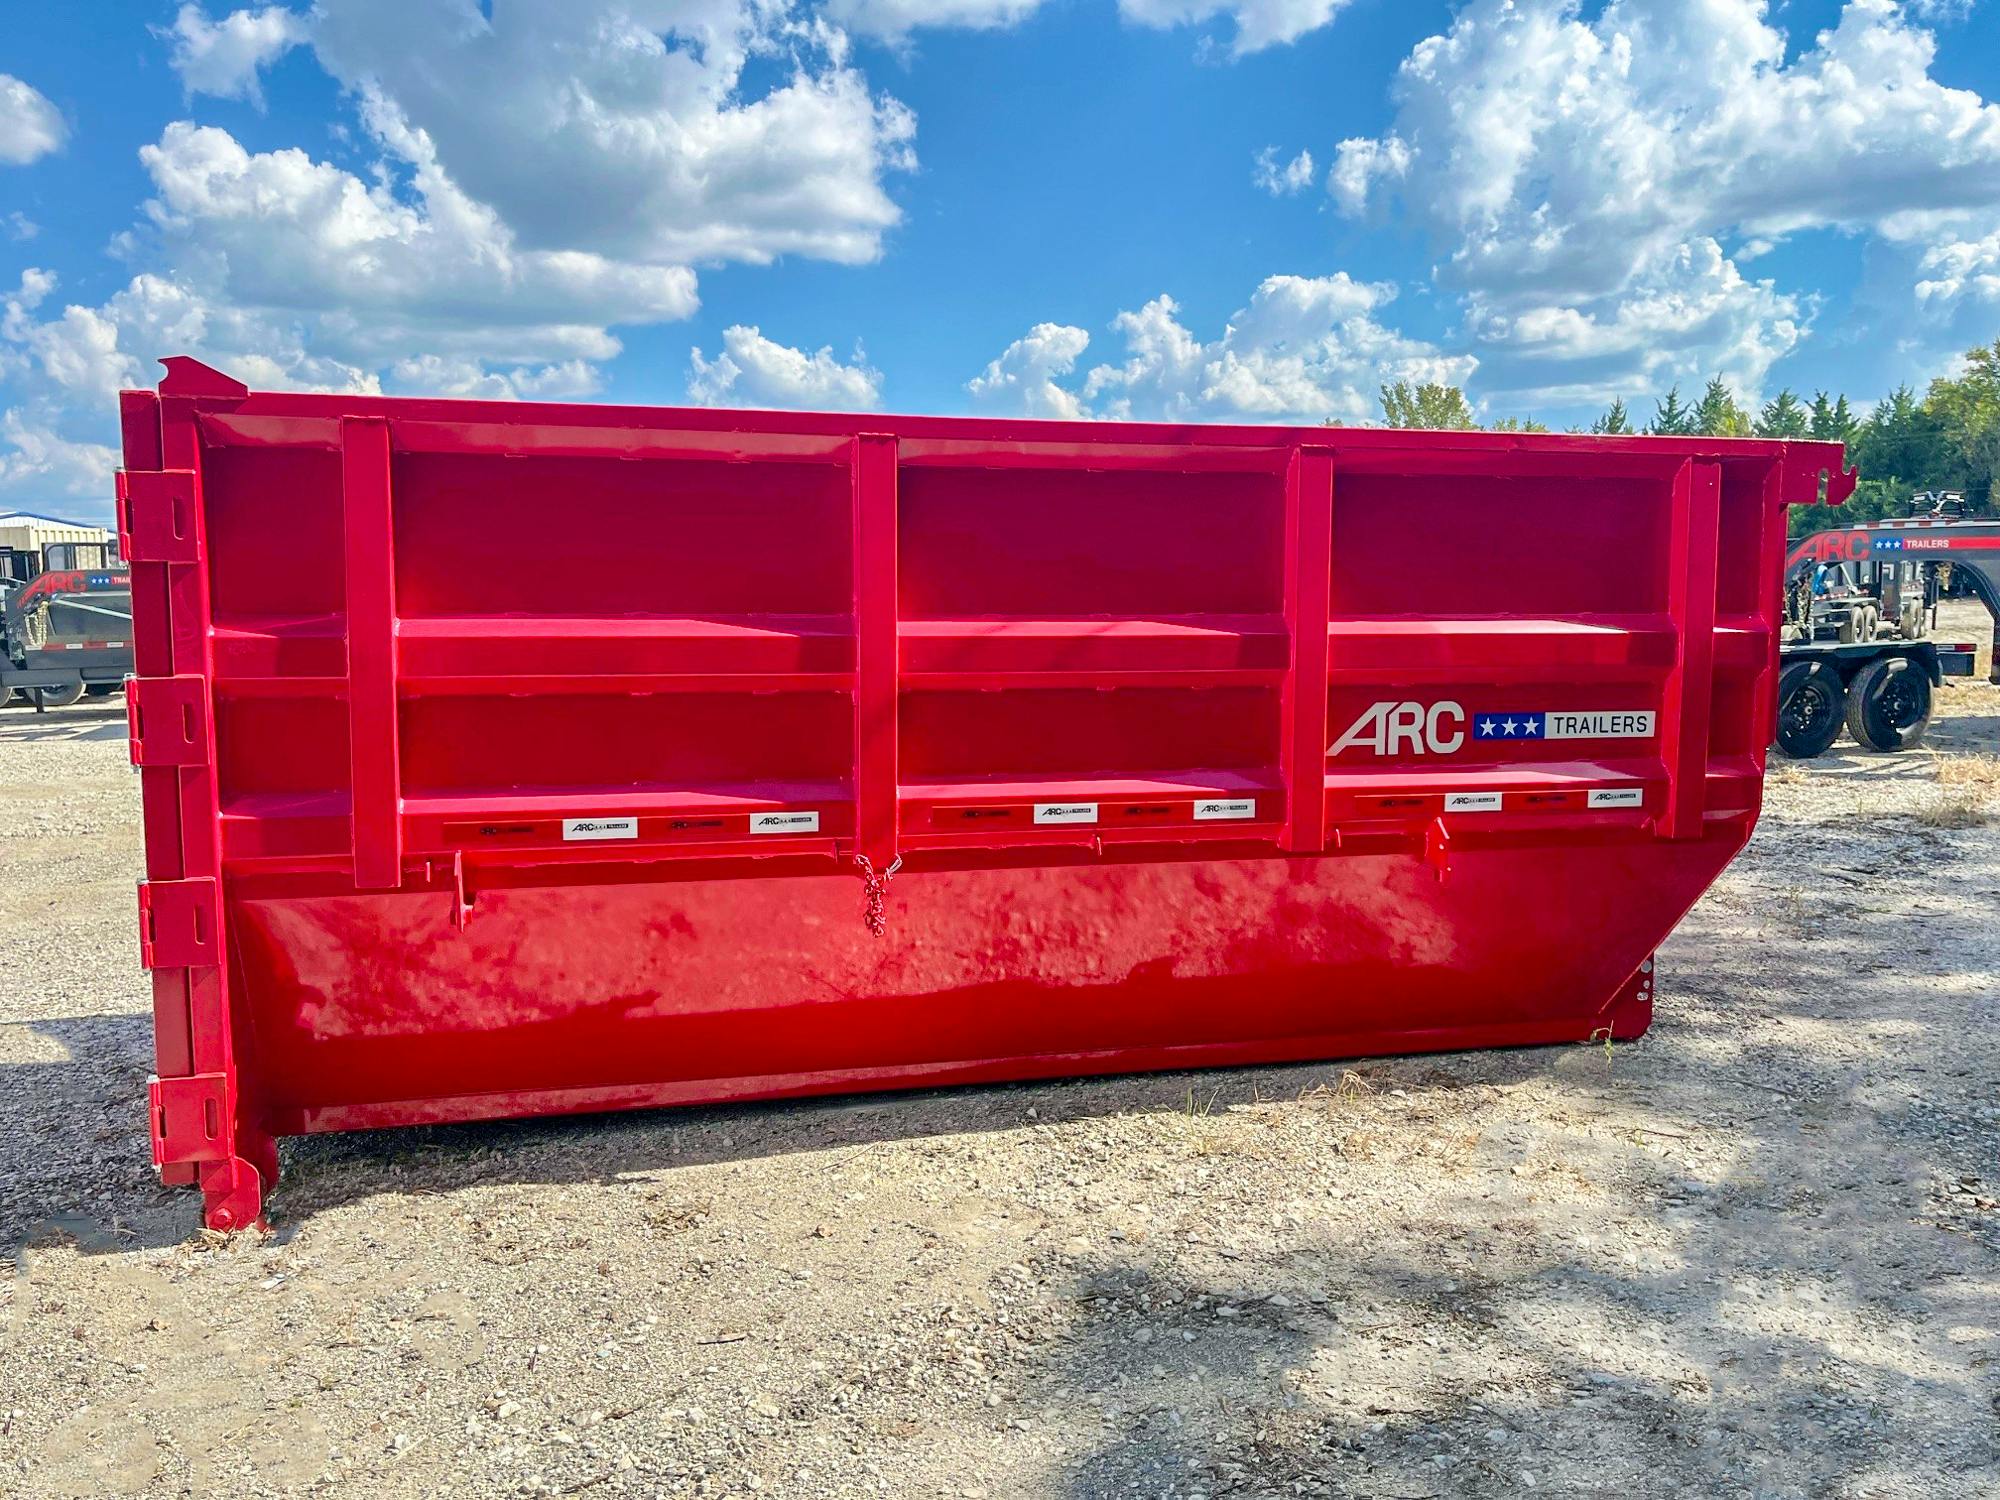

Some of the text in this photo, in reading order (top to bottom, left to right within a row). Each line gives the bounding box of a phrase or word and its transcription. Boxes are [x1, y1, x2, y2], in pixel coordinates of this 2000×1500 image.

[1787, 531, 1950, 568] ARC TRAILERS
[17, 571, 87, 608] ARC
[1326, 701, 1648, 756] ARC TRAILERS
[1451, 797, 1470, 805] ARC
[1593, 793, 1612, 801] ARC
[1042, 807, 1062, 816] ARC
[1201, 804, 1220, 813] ARC
[758, 816, 780, 826] ARC
[571, 823, 595, 832] ARC
